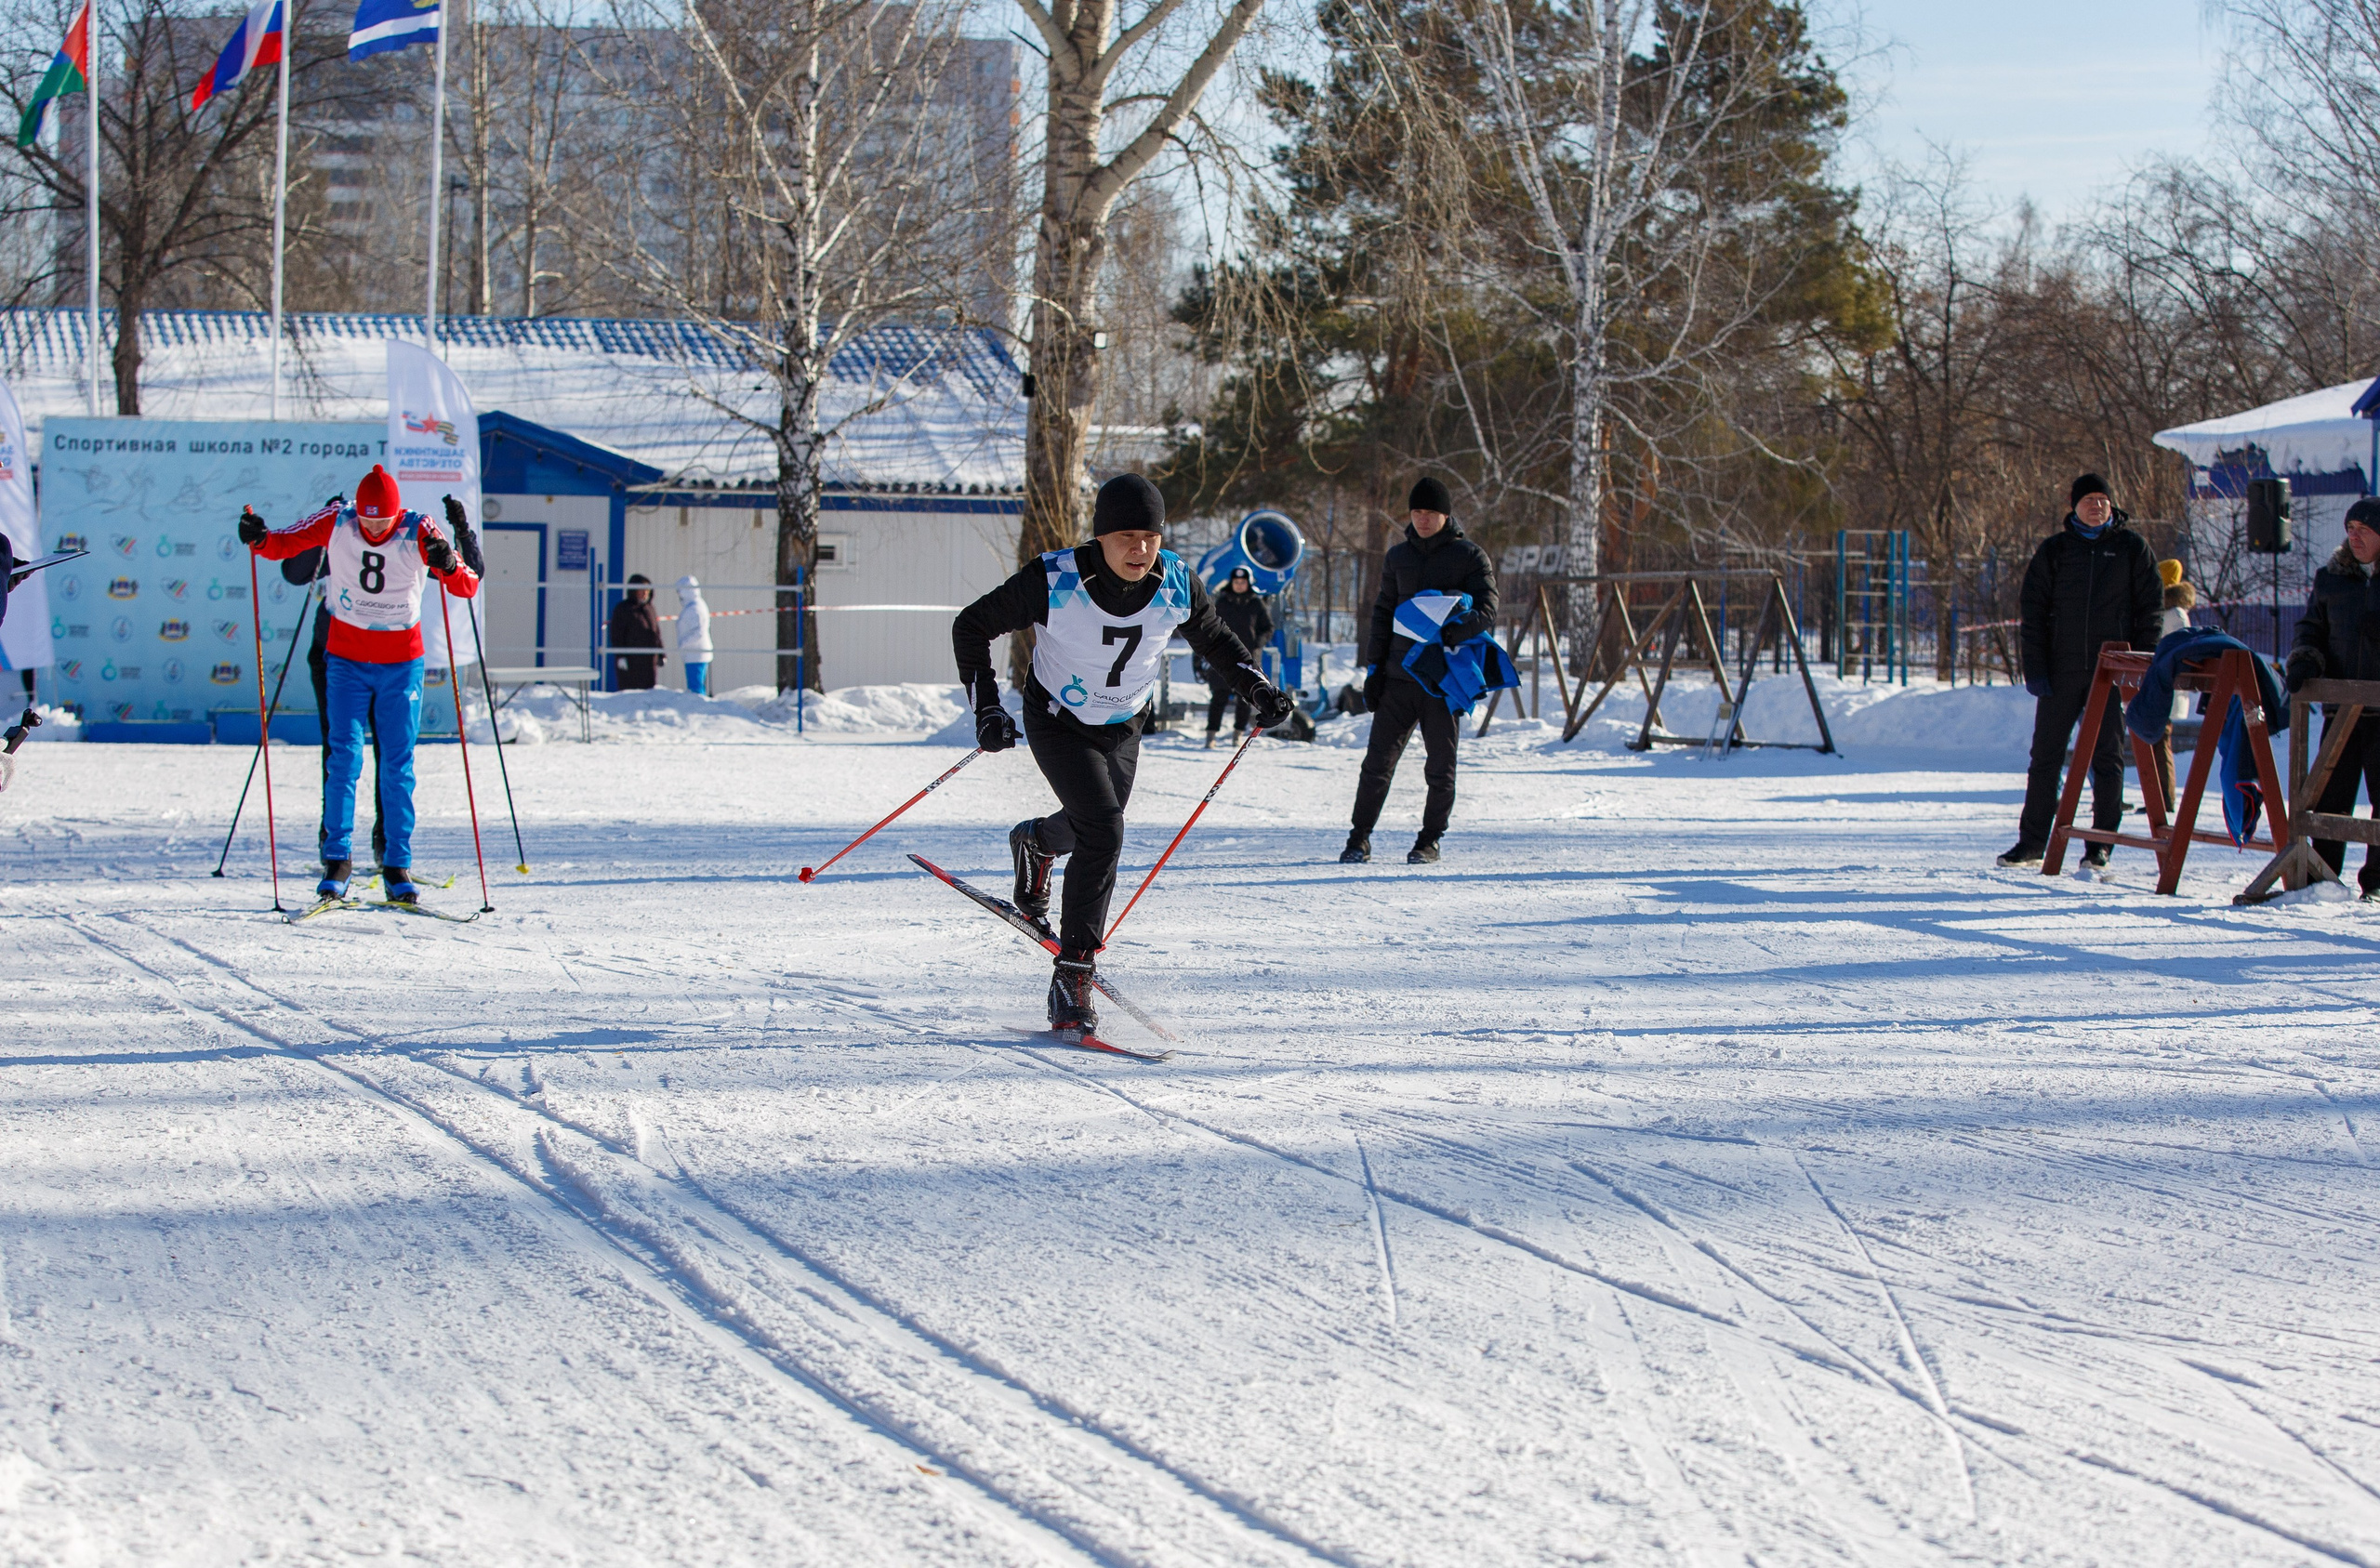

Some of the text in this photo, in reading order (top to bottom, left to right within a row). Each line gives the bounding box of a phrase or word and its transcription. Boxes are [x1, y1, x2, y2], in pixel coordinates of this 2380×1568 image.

[54, 434, 177, 455] Спортивная
[189, 440, 253, 454] школа
[261, 439, 293, 455] №2
[300, 441, 369, 458] города
[359, 550, 386, 595] 8
[1102, 624, 1143, 688] 7
[1009, 914, 1040, 942] ROSSIGNOL
